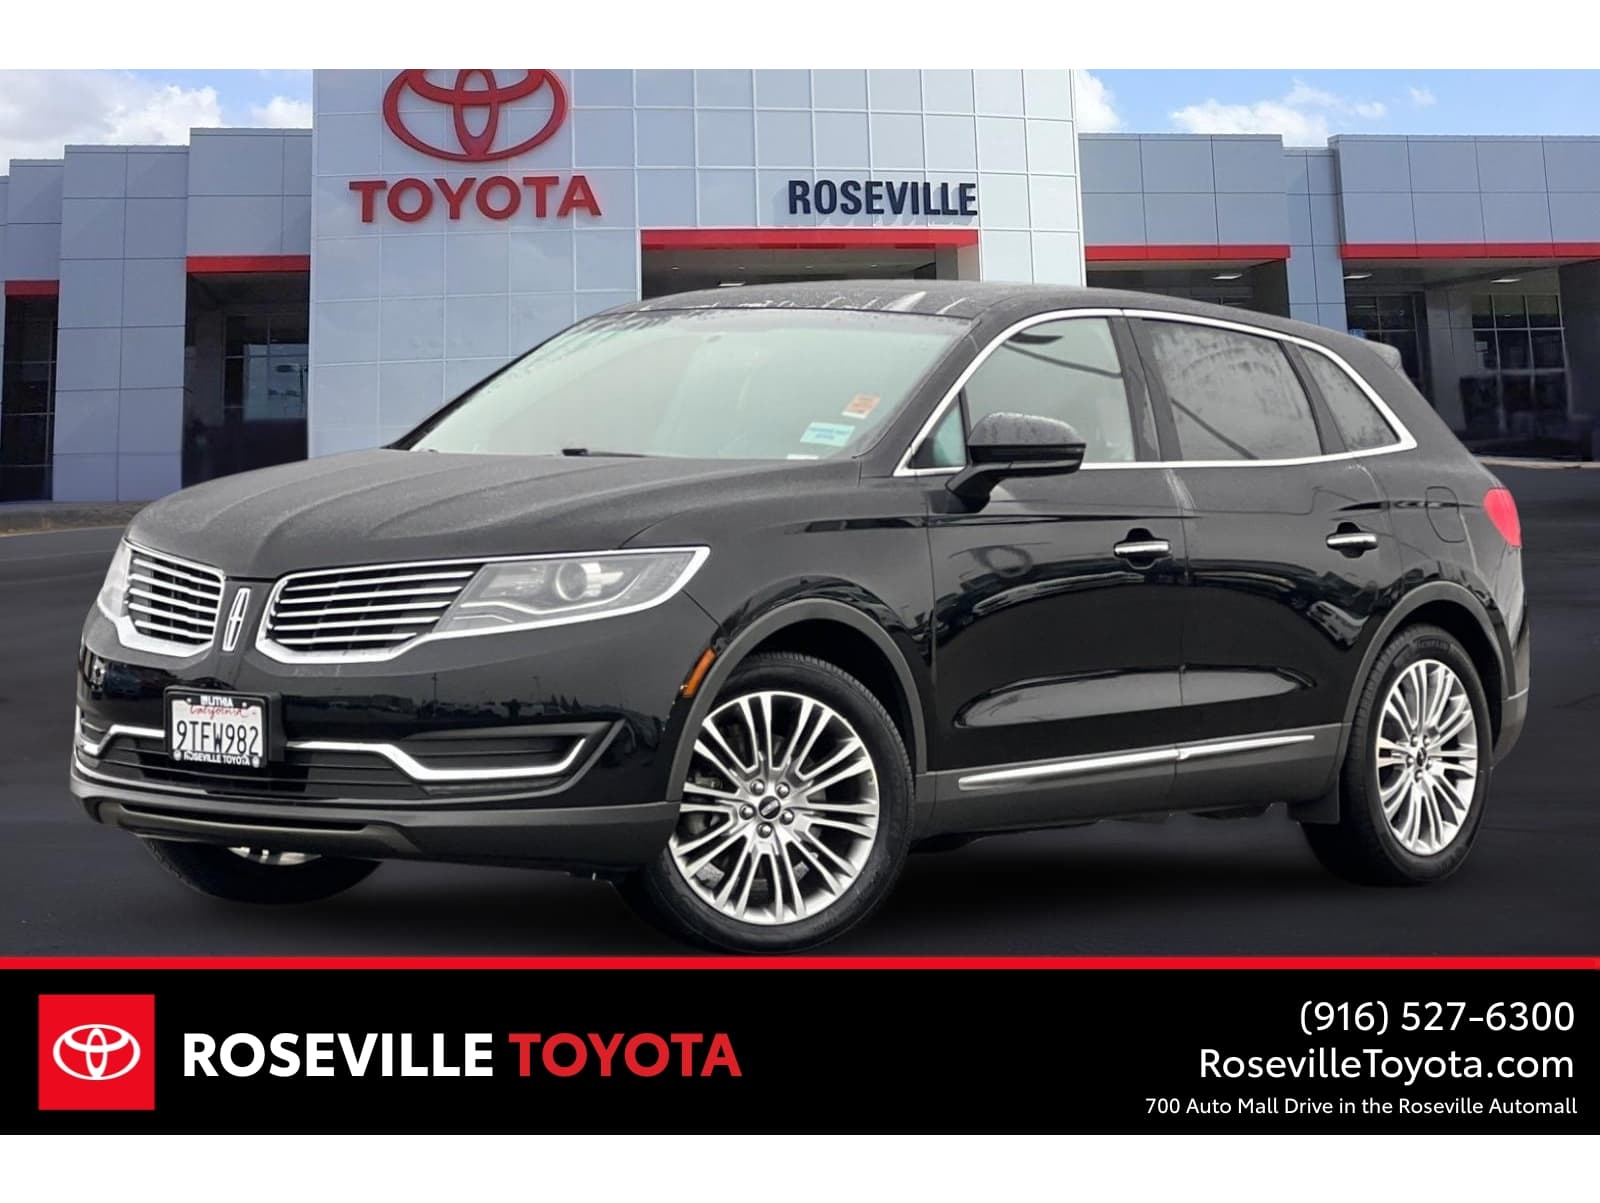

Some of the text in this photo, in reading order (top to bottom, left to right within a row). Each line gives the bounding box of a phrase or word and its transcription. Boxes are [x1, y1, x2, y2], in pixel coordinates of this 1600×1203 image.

[349, 175, 602, 223] TOYOTA
[788, 180, 978, 216] ROSEVILLE
[176, 720, 259, 756] 9TFW982
[183, 751, 251, 766] ROSEVILLE TOYOTA
